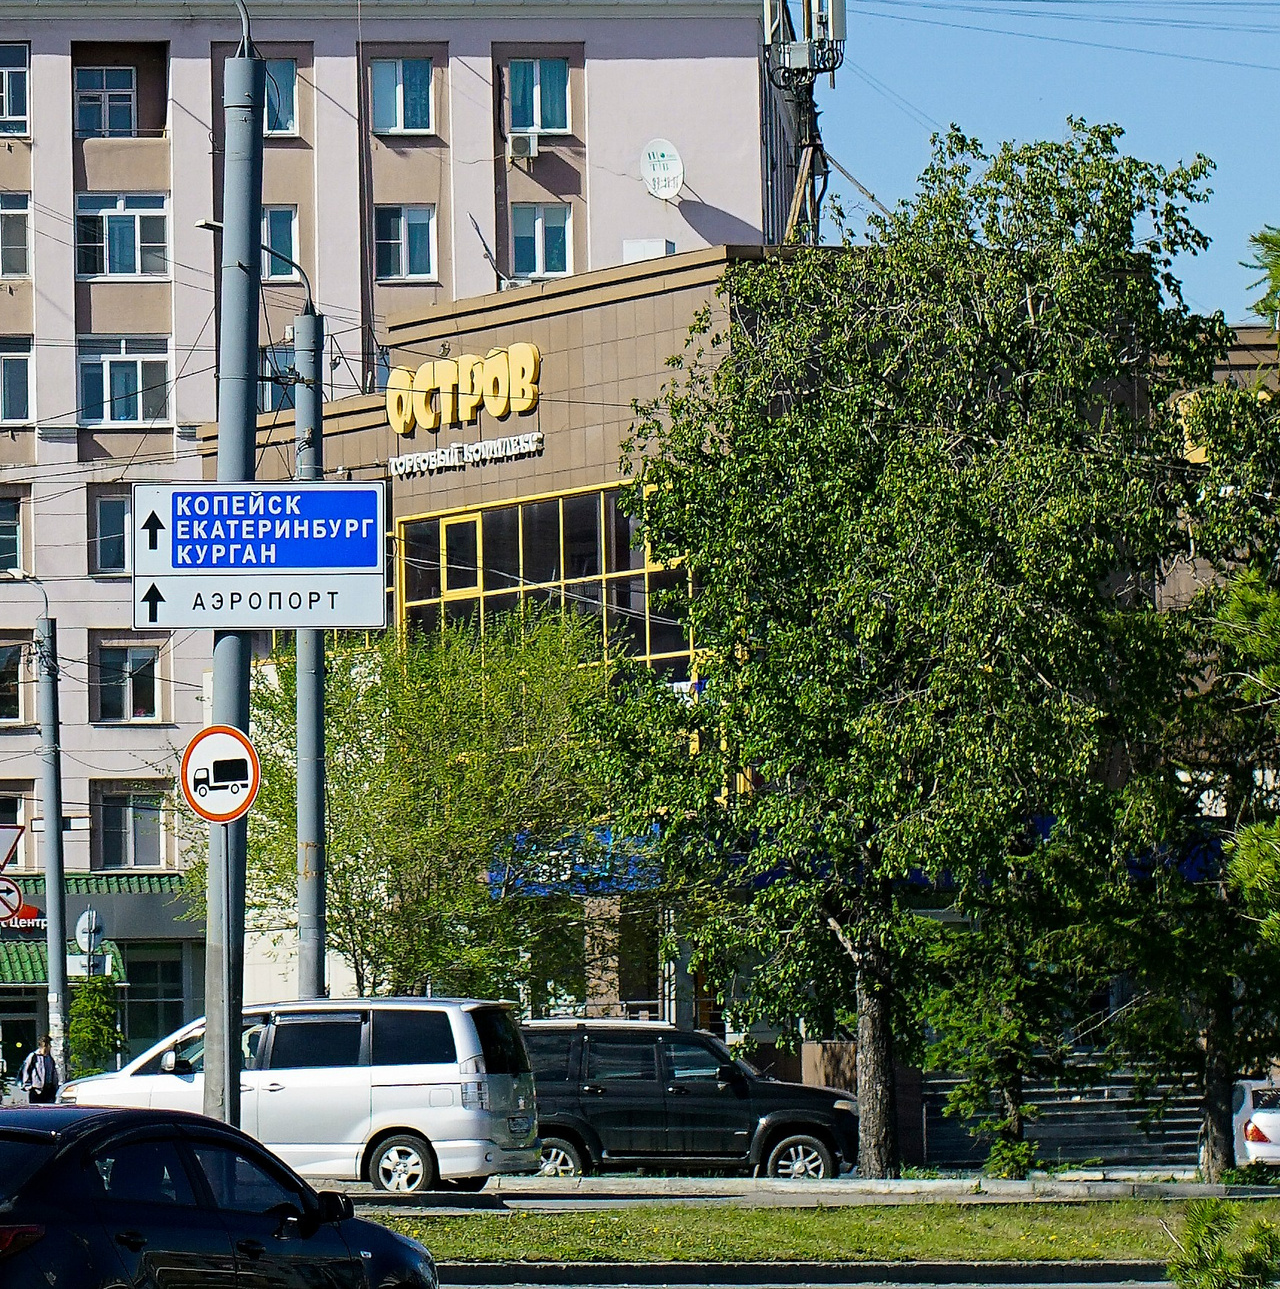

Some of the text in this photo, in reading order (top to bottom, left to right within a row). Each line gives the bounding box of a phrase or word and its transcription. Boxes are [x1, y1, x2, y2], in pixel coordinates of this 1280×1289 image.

[386, 342, 540, 434] ОСТРОВ
[388, 442, 465, 476] ТОРГОВЫЙ
[176, 492, 301, 516] КОПЕЙСК
[176, 518, 374, 540] ЕКАТЕРИНБУРГ
[176, 543, 277, 564] КУРГАН
[192, 591, 339, 611] АЭРОПОРТ
[9, 917, 48, 930] Центр
